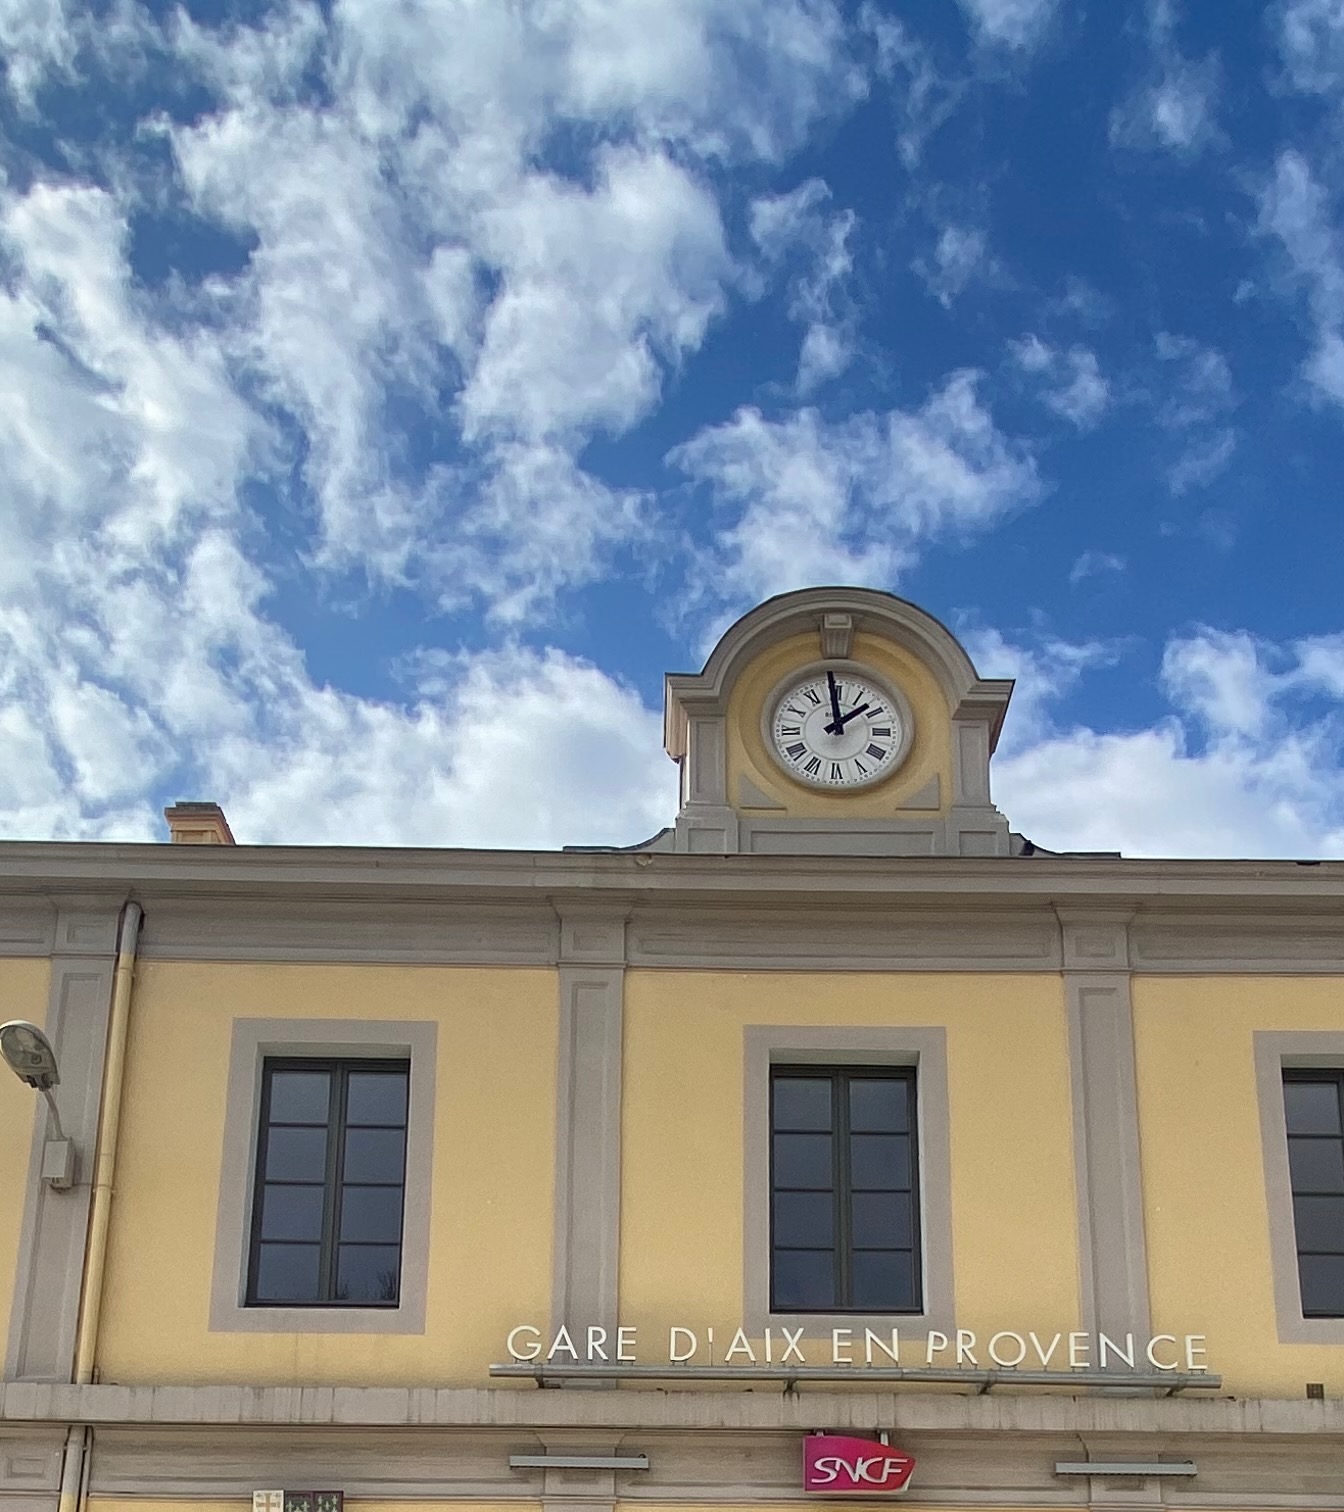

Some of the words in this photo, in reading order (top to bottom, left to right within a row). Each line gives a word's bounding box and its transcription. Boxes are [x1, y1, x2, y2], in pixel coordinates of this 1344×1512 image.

[506, 1324, 637, 1361] GARE
[669, 1326, 806, 1363] D'AIX
[832, 1328, 899, 1364] EN
[926, 1328, 1208, 1370] PROVENCE
[811, 1456, 909, 1484] SNCF
